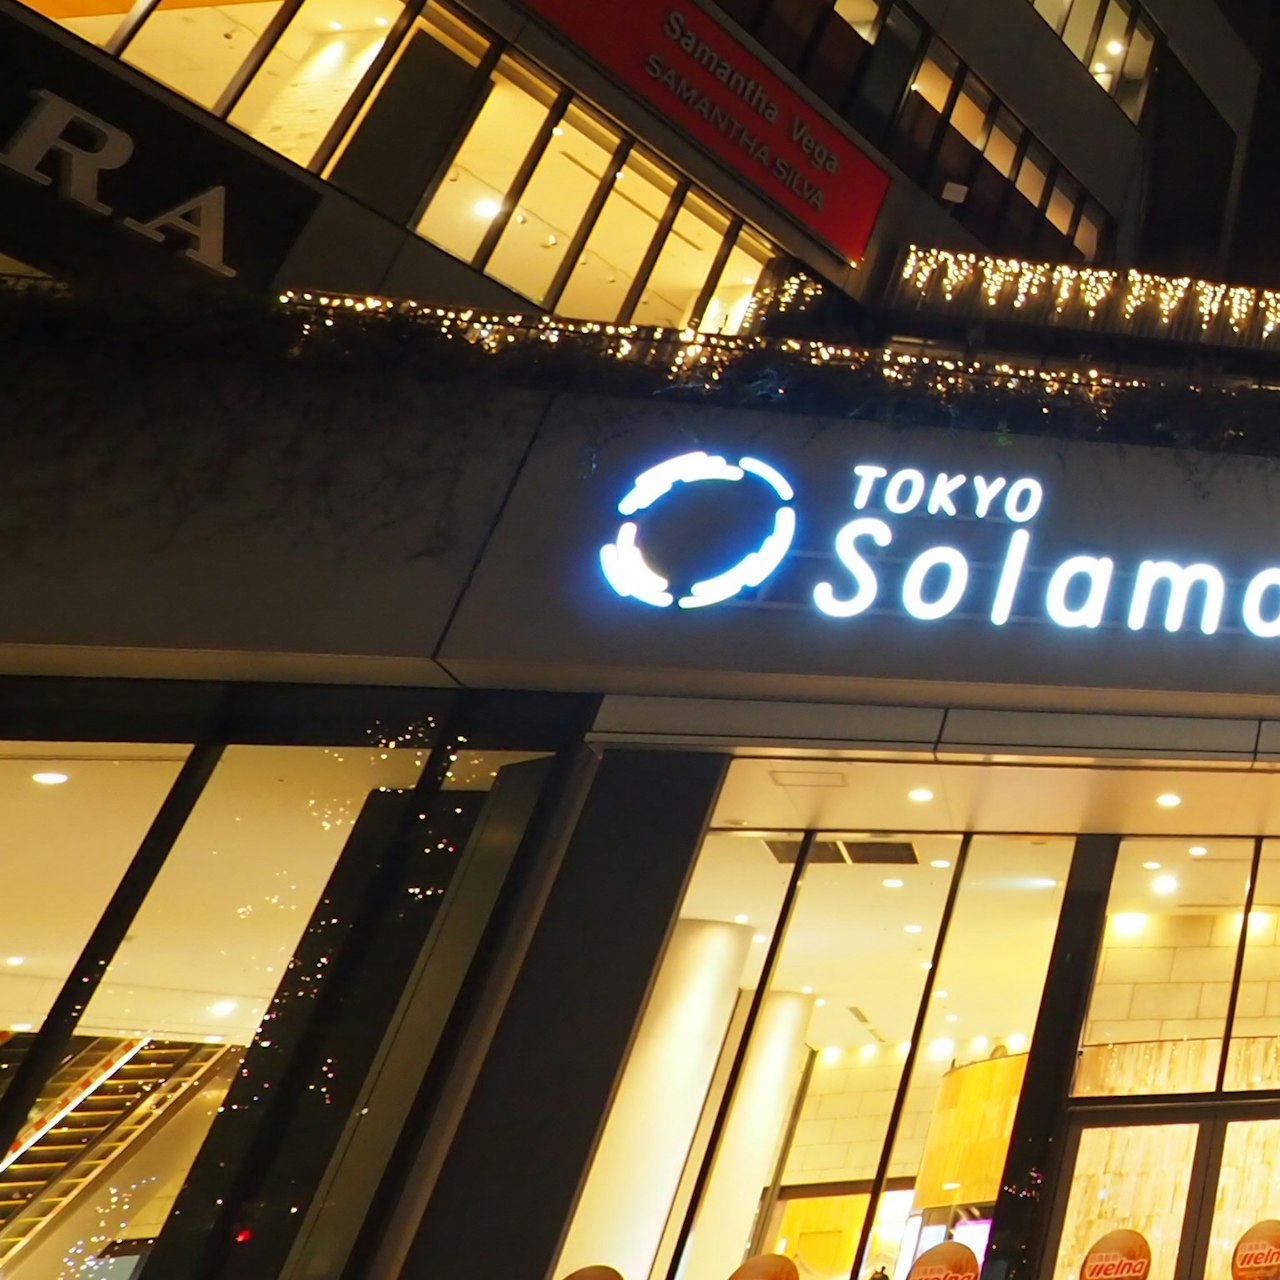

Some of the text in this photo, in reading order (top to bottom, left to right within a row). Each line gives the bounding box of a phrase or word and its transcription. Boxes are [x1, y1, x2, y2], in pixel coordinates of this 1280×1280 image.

[645, 53, 825, 211] SAMANTHA SILVA
[663, 10, 840, 175] Samantha Vega
[851, 463, 1046, 524] TOKYO
[1087, 1259, 1146, 1278] welna
